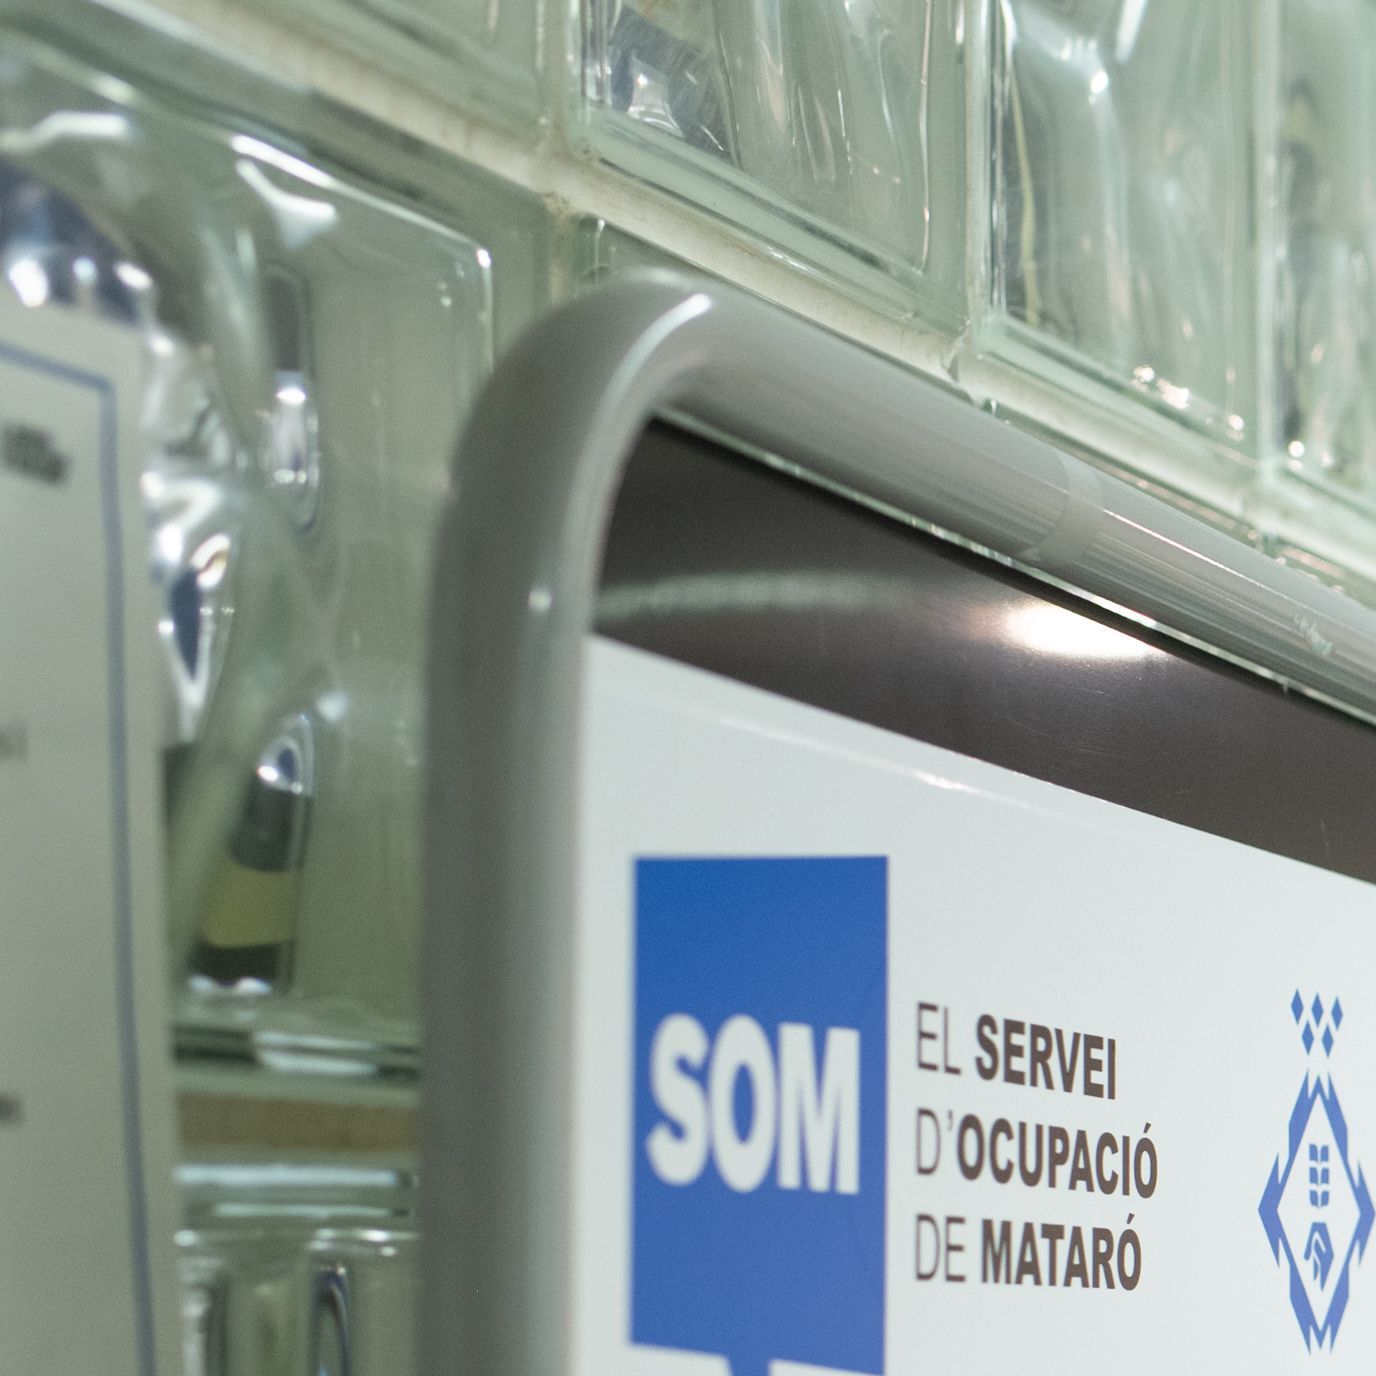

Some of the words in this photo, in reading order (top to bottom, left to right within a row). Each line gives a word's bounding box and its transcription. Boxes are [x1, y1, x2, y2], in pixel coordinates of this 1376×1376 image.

[915, 1001, 961, 1075] EL
[975, 1012, 1117, 1101] SERVEI
[645, 1011, 861, 1195] SOM
[915, 1212, 966, 1283] DE
[981, 1212, 1142, 1292] MATARÓ
